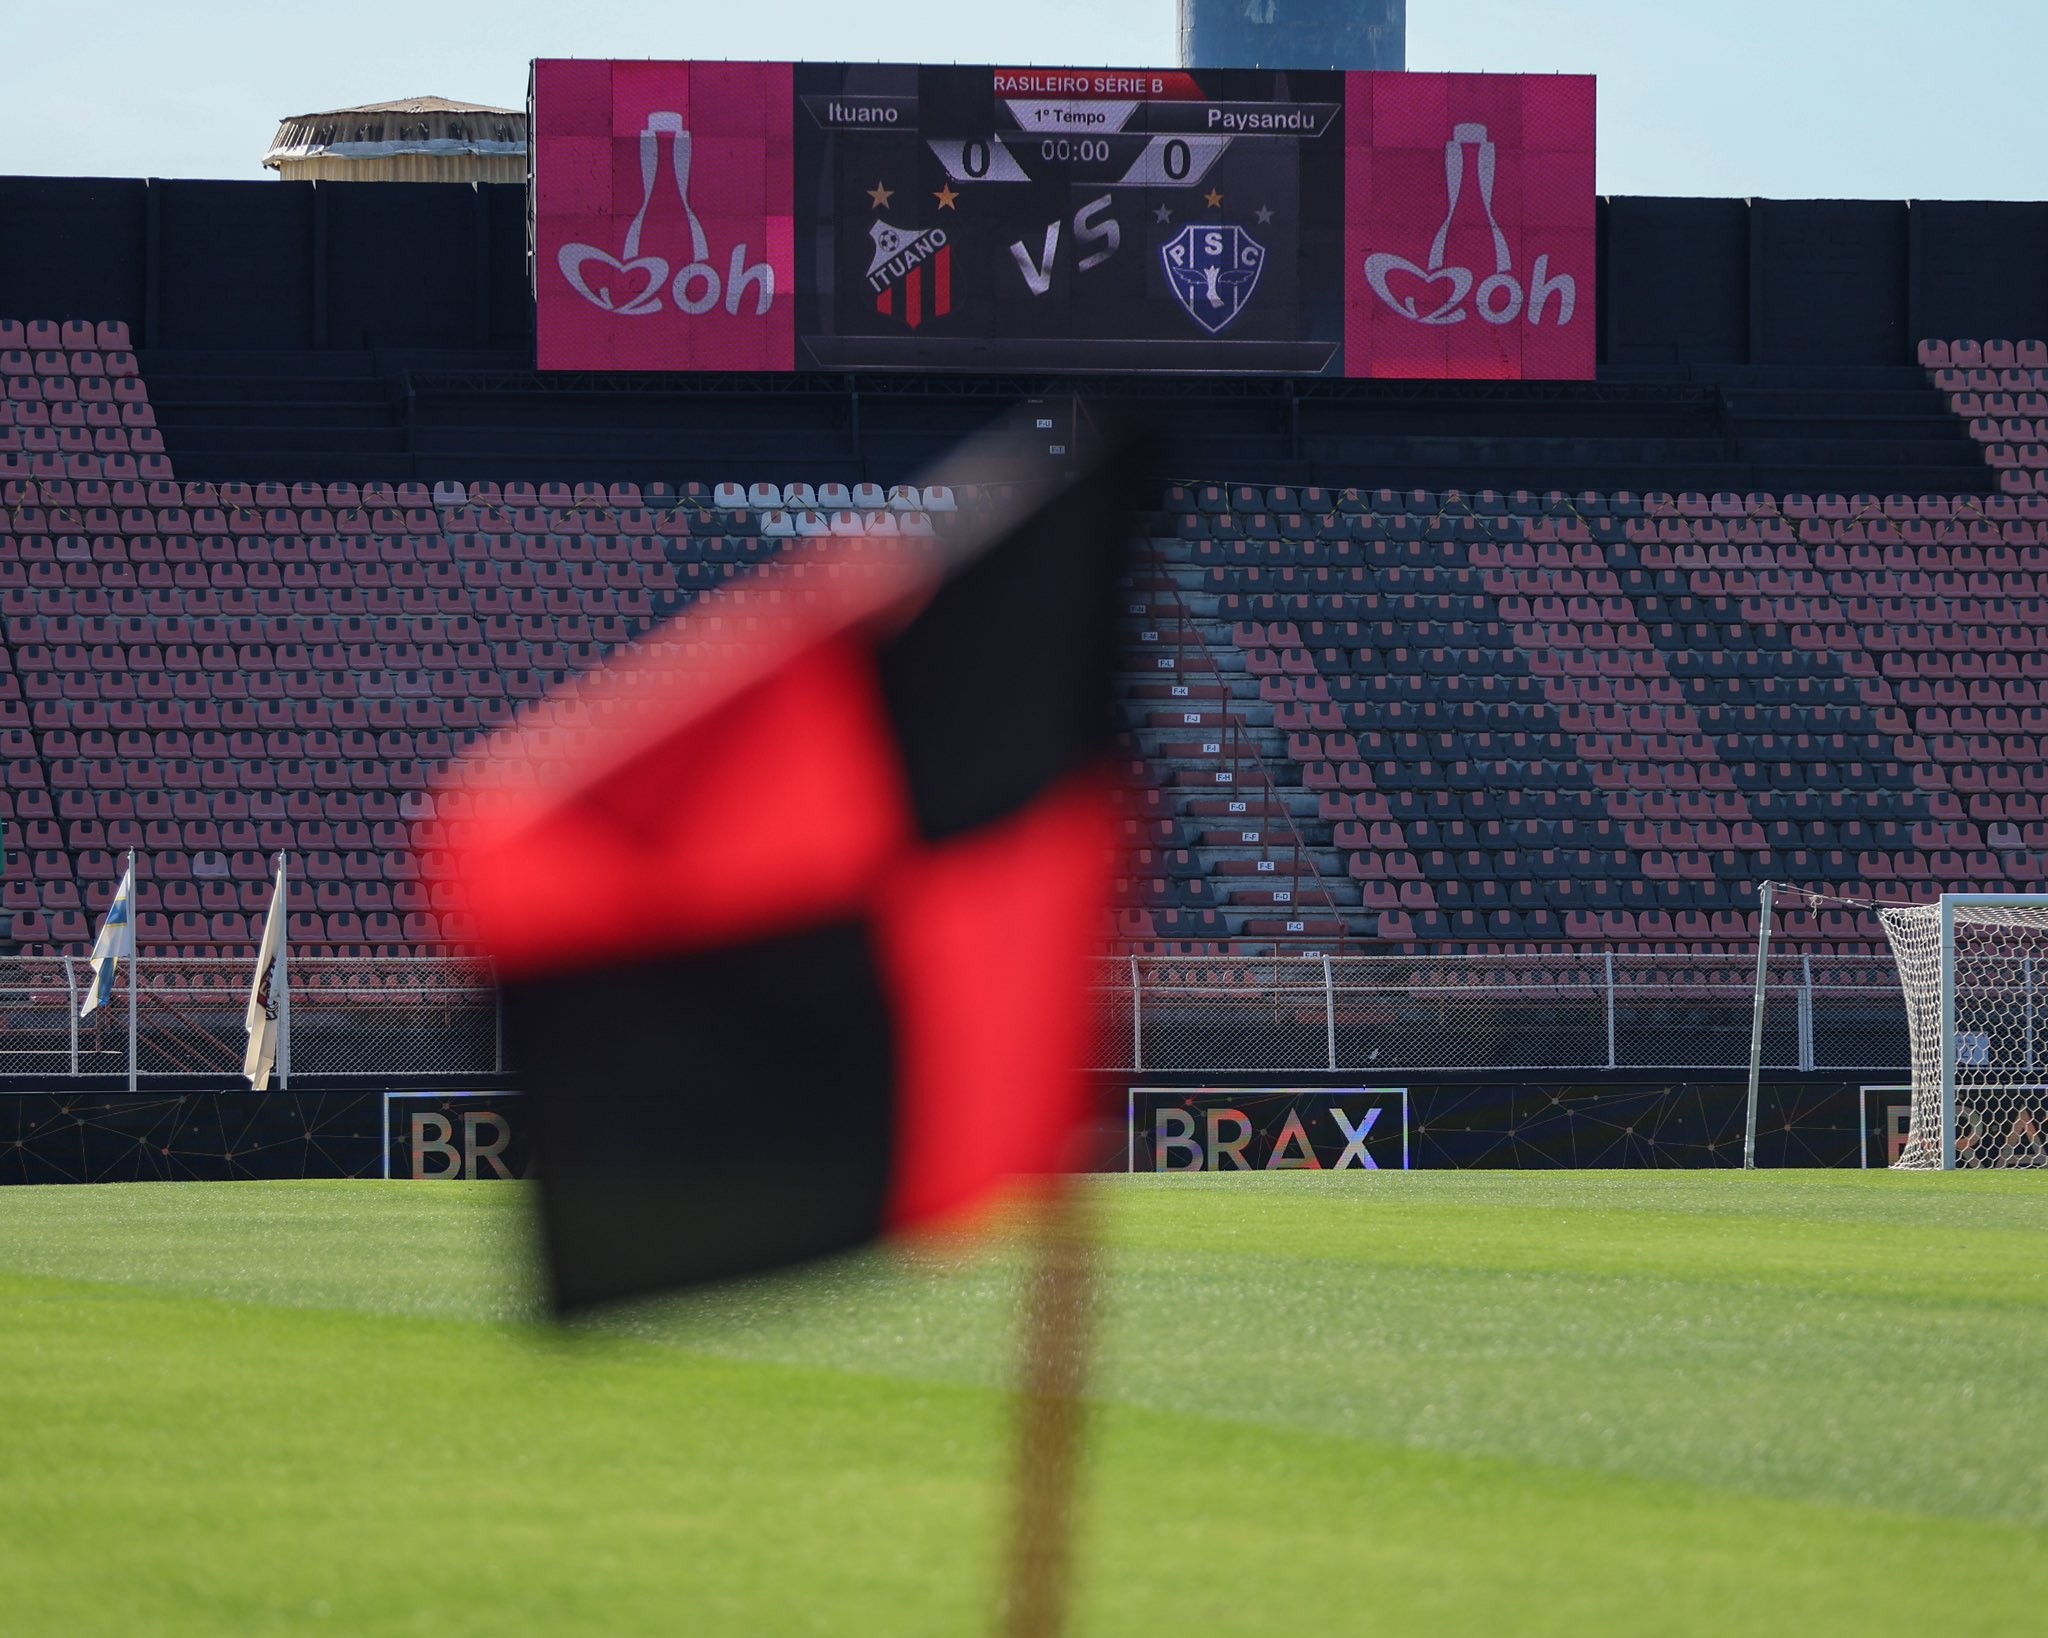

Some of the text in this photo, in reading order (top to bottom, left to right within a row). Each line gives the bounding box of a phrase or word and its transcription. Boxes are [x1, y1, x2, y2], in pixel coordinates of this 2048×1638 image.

[1094, 75, 1147, 93] SÉRIE
[1151, 79, 1164, 94] B
[828, 102, 898, 122] Ituano
[1053, 109, 1106, 126] Tempo
[1207, 109, 1315, 132] Paysandu
[962, 138, 991, 179] 0
[1041, 139, 1110, 162] 00:00
[1163, 138, 1191, 180] 0
[868, 227, 948, 293] ITUANO
[1173, 687, 1187, 695] F-K
[1217, 774, 1231, 782] F-H
[1230, 803, 1245, 811] F-G
[1259, 862, 1273, 870] F-E
[411, 1111, 517, 1180] BR
[1155, 1107, 1382, 1172] BRAX
